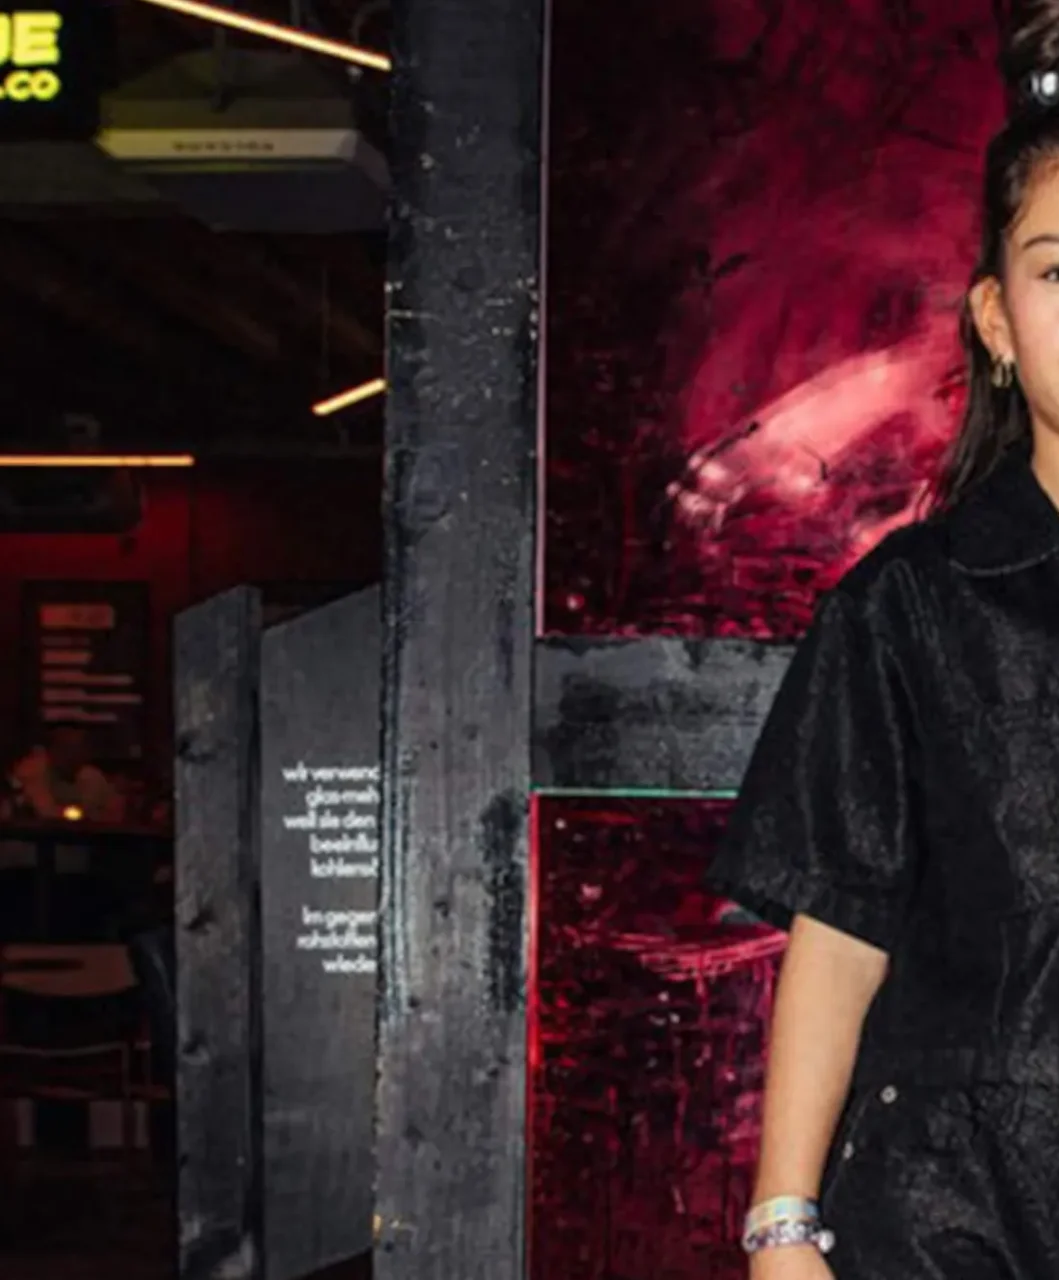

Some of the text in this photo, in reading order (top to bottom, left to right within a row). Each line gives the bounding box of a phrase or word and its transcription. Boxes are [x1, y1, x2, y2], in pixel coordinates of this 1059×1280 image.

[0, 11, 62, 66] E
[282, 809, 376, 829] weil sie den
